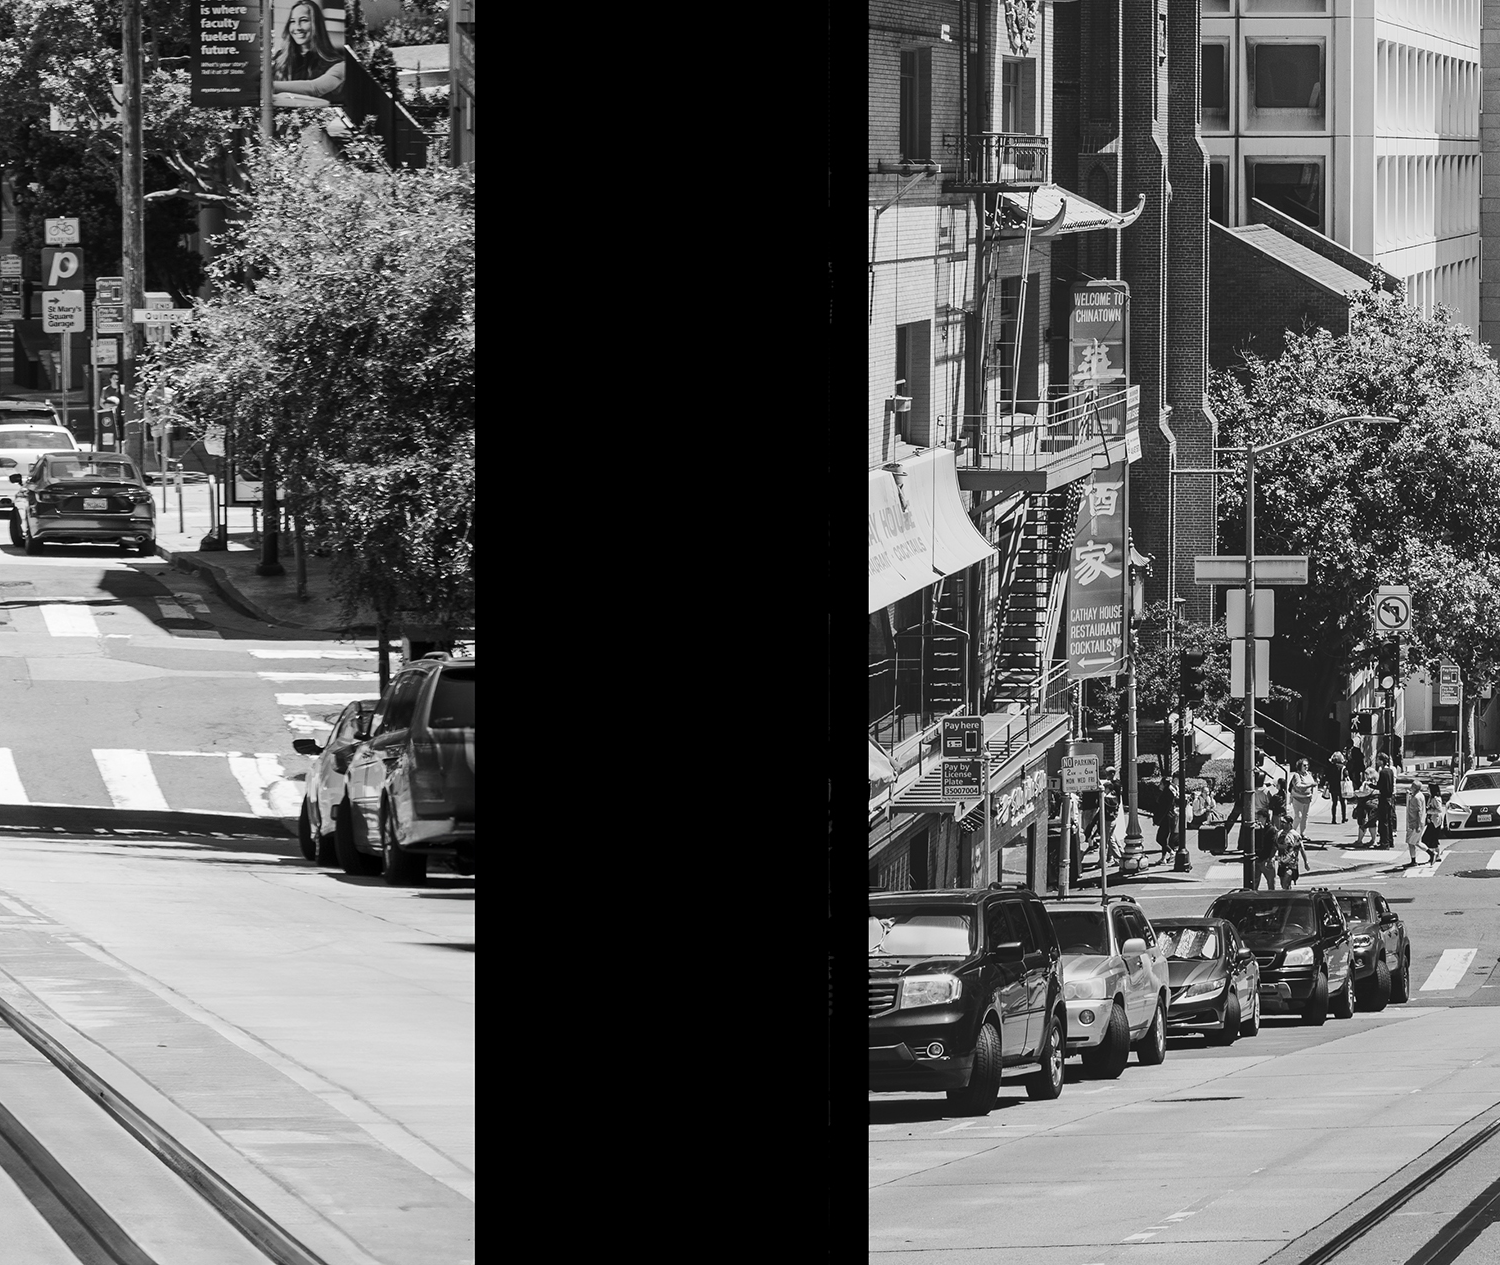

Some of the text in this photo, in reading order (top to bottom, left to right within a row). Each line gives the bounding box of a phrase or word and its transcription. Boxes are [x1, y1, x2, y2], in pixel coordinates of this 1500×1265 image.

[201, 5, 247, 15] is where
[201, 18, 240, 30] faculty
[201, 32, 256, 43] fueled my
[201, 45, 239, 55] future.
[1074, 292, 1124, 306] WELCOME TO
[48, 313, 73, 321] Square
[1075, 308, 1121, 322] CHINATOWN
[1071, 338, 1128, 586] 華酒家
[1070, 604, 1123, 623] CATHAY HOUSE
[1070, 621, 1122, 638] RESTAURANT
[1070, 638, 1113, 656] COCKTAILS
[944, 721, 979, 731] Pay here
[944, 763, 970, 772] Pay by
[1063, 757, 1096, 768] NO PARKING
[944, 778, 963, 786] Plate
